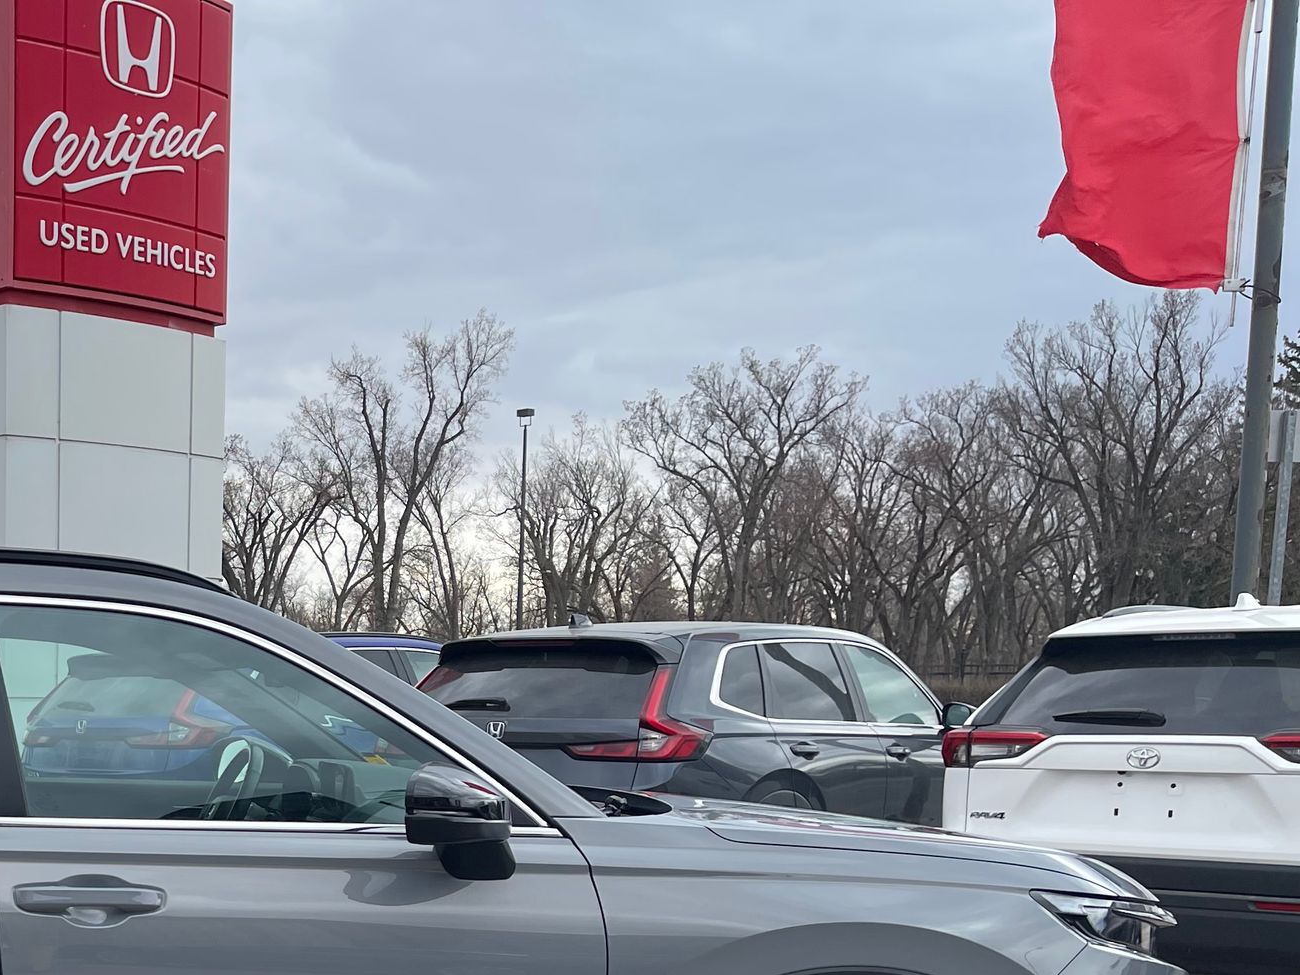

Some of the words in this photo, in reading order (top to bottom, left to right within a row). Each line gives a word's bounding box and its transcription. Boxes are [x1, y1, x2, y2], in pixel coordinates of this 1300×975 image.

[21, 111, 225, 195] Certified
[39, 219, 109, 255] USED
[116, 232, 216, 278] VEHICLES
